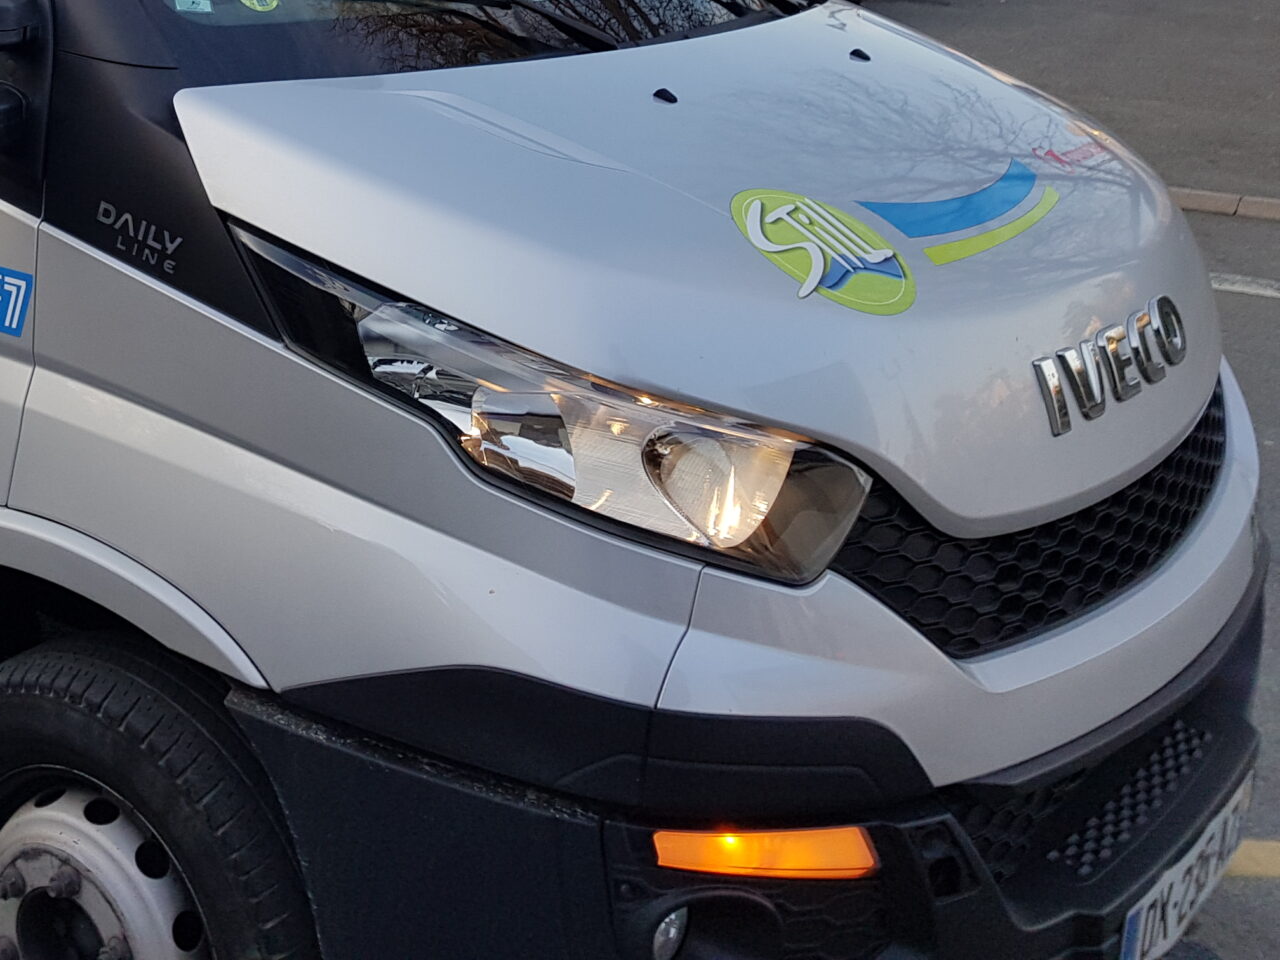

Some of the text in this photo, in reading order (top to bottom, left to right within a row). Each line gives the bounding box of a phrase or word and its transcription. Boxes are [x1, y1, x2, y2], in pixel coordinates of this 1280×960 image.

[96, 199, 183, 252] DAILY
[116, 235, 177, 276] LINE
[1032, 294, 1189, 437] IVECO
